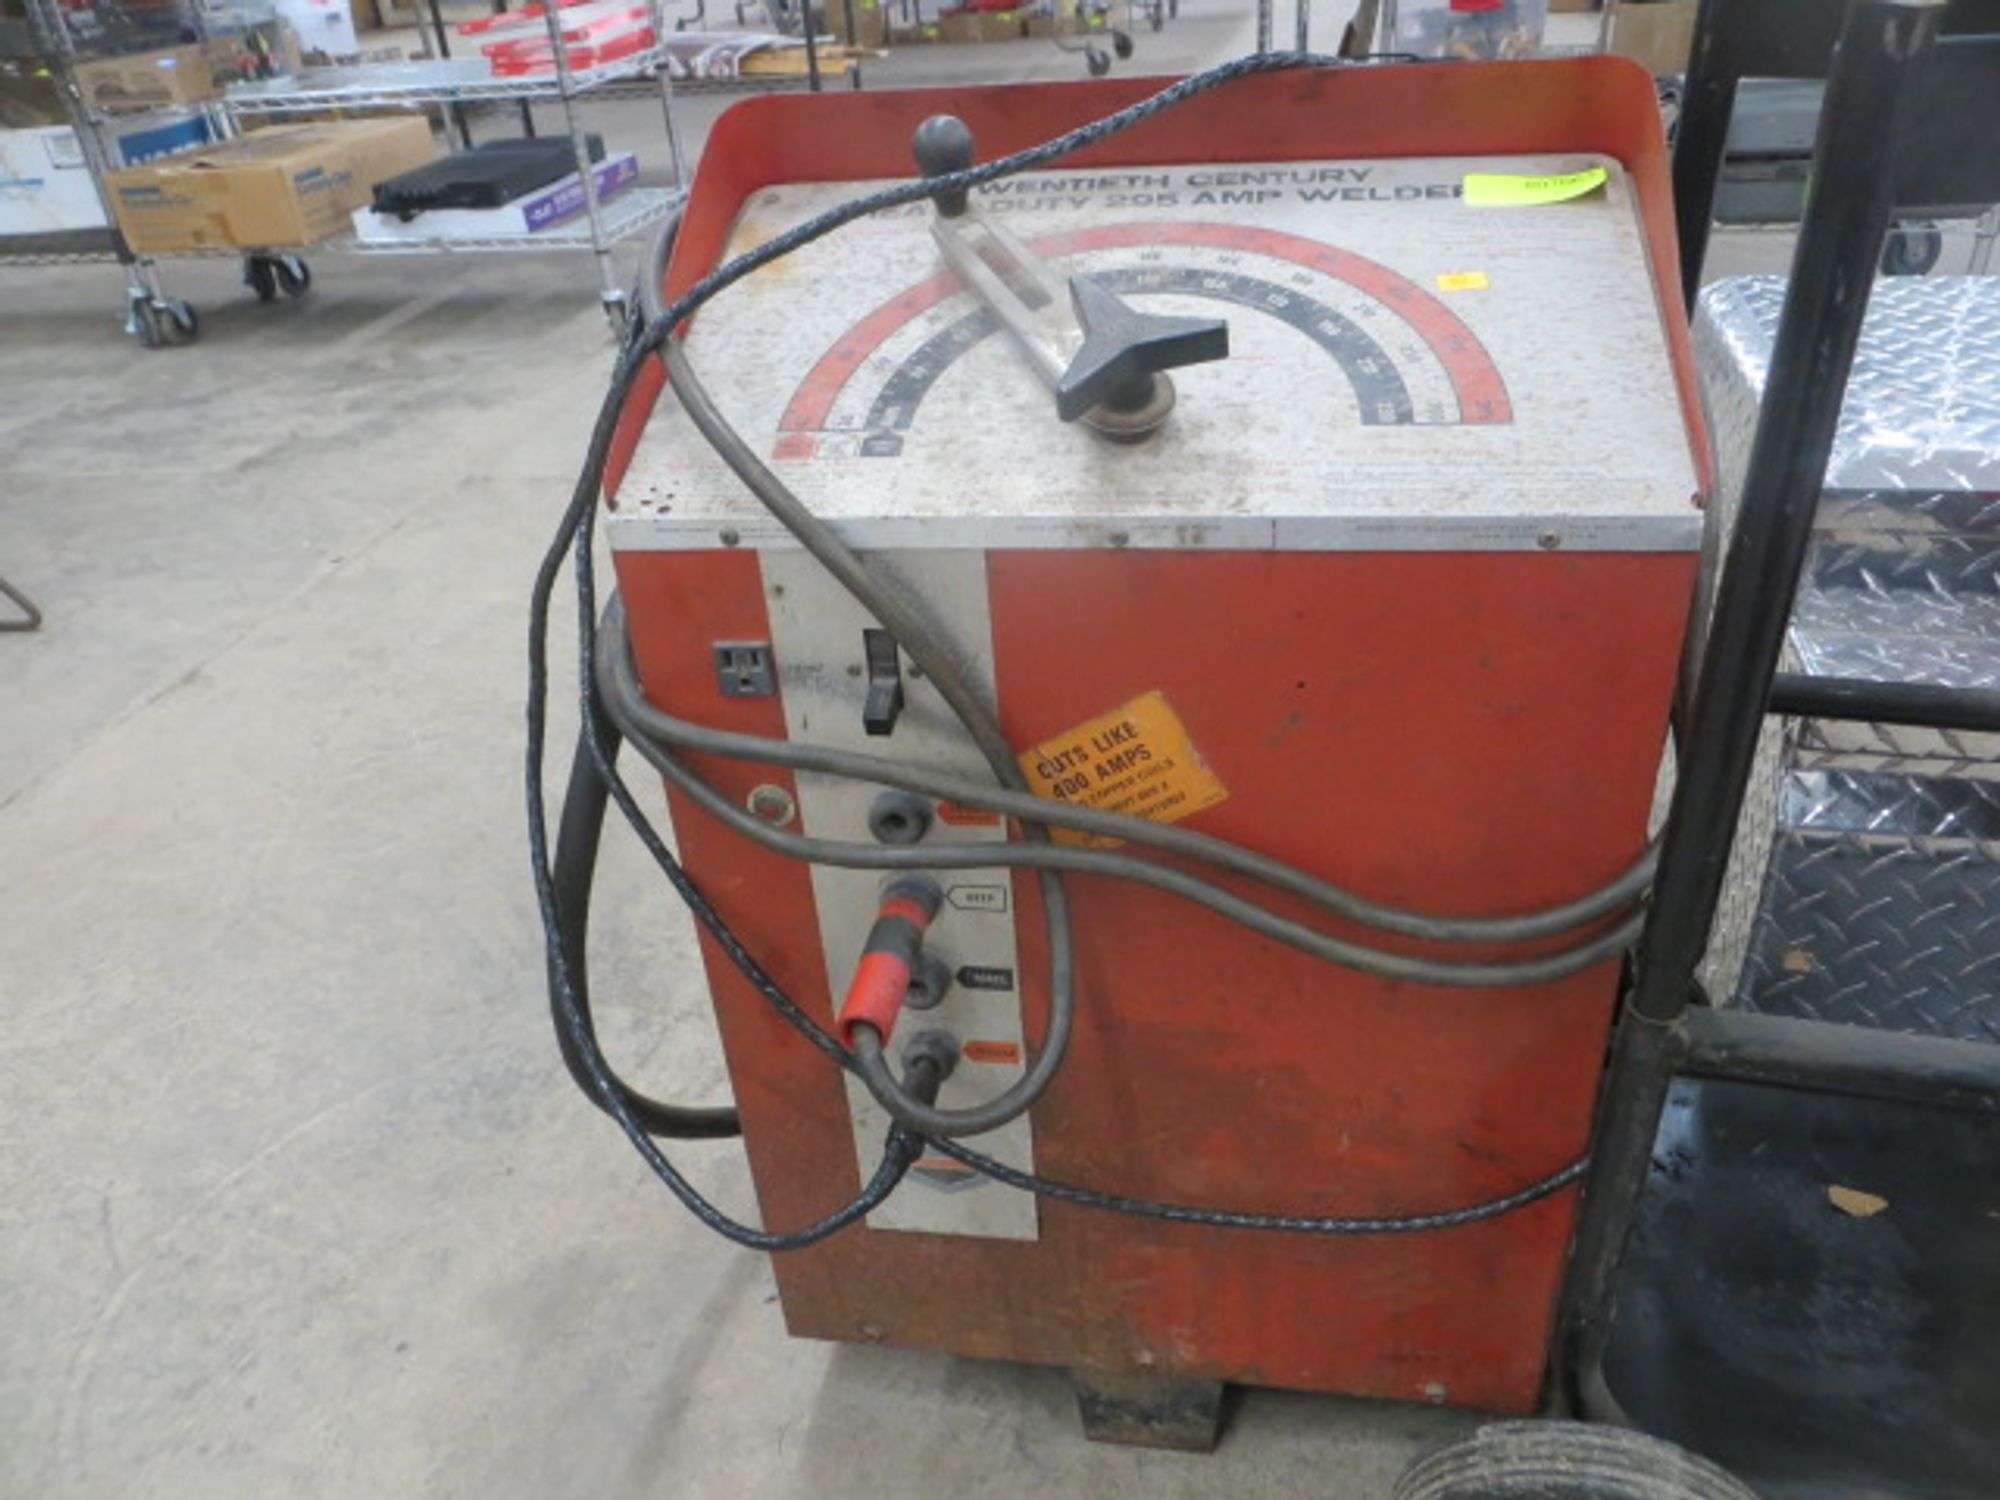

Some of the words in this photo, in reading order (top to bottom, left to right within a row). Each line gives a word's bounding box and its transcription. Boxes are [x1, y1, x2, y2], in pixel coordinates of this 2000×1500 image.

[1186, 167, 1372, 187] CENTURY
[988, 195, 1090, 211] DUTY
[1106, 193, 1178, 208] 295
[1193, 189, 1282, 205] AMP
[1037, 746, 1089, 779] CUTS
[1091, 721, 1138, 753] LIKE
[1053, 772, 1089, 799] 400
[1095, 744, 1151, 781] AMPS
